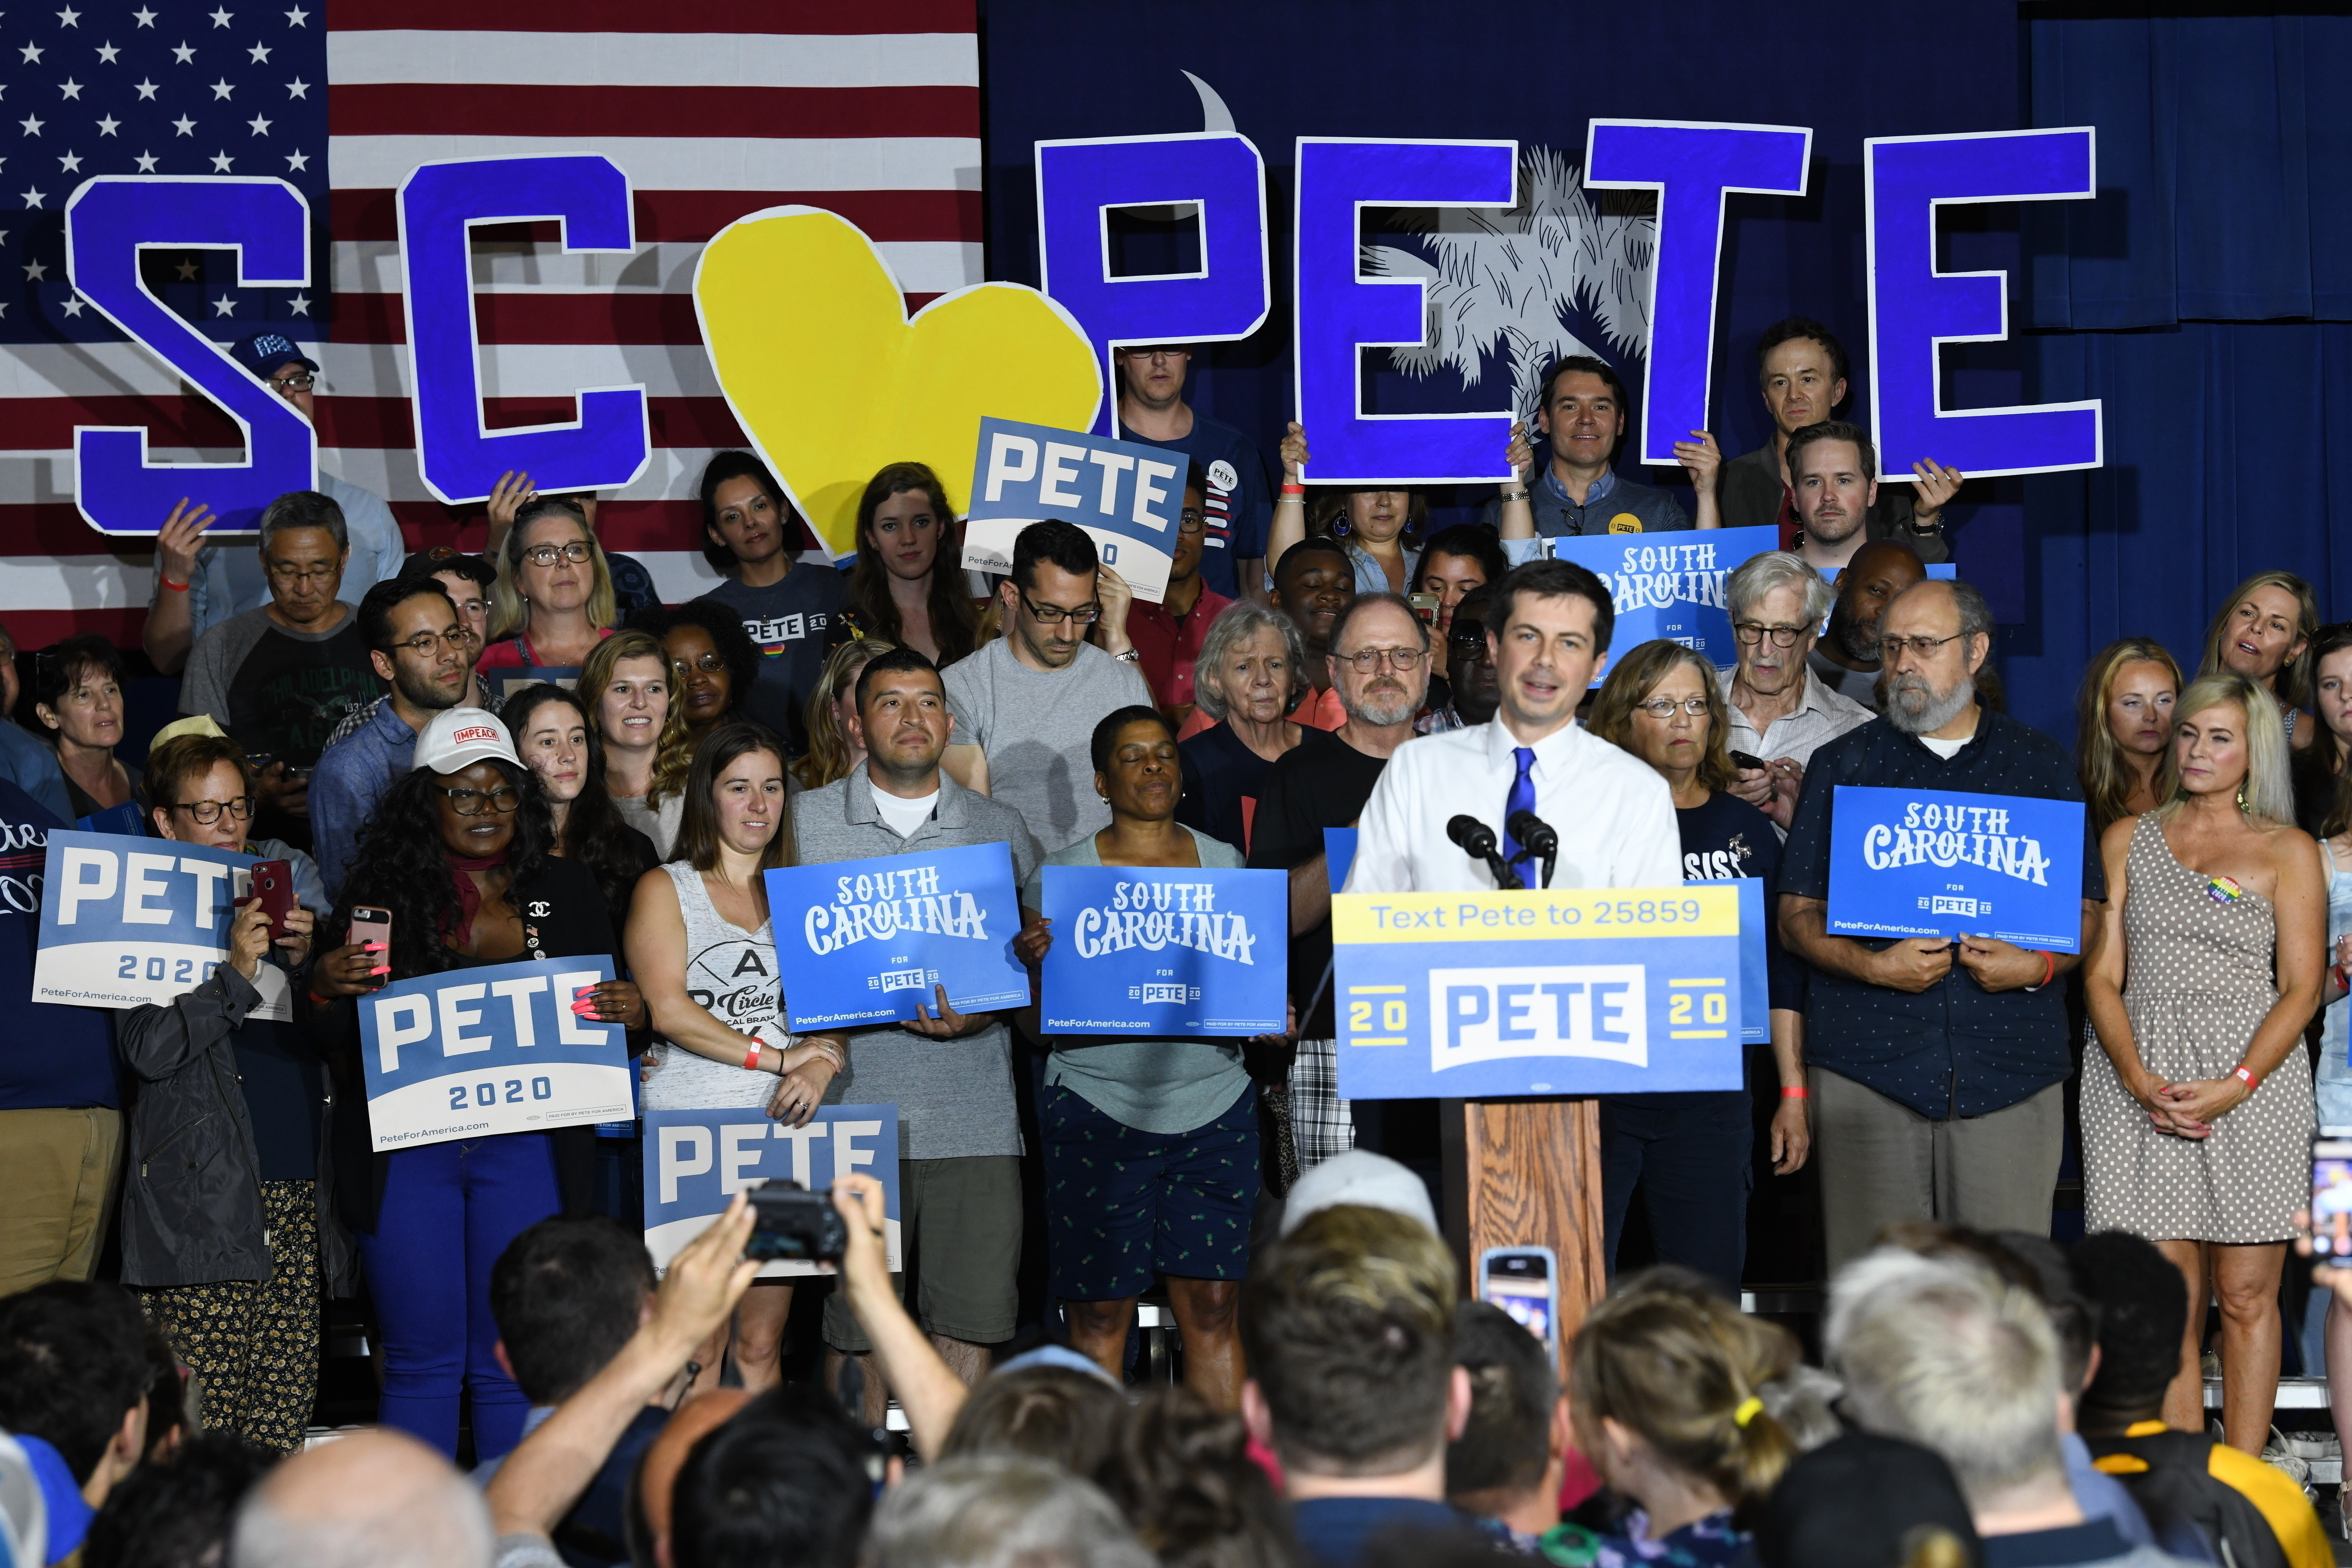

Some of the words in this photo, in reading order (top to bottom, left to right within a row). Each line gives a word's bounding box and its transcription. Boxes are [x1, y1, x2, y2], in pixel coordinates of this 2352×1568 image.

[1035, 117, 2103, 484] PETE
[985, 432, 1177, 533] PETE
[1214, 468, 1234, 484] PETE
[1622, 544, 1717, 574] SOUTH
[1596, 567, 1733, 615] AROLIN
[745, 618, 799, 639] PETE
[810, 618, 827, 628] 20
[457, 729, 497, 741] IMPEACH
[1904, 802, 2010, 835] SOUTH
[1864, 824, 2050, 887] CAROLINA
[58, 847, 252, 930] PET
[837, 866, 939, 905] SOUTH
[1112, 881, 1215, 912] SOUTH
[2212, 889, 2227, 901] 2020
[1370, 905, 1446, 929] Text
[1459, 904, 1536, 927] Pete
[1547, 904, 1582, 925] to
[1594, 899, 1700, 924] 25859
[1936, 899, 1974, 913] PETE
[805, 890, 989, 956] CAROLINA
[1075, 905, 1256, 966] CAROLINA
[1834, 921, 1939, 935] PeteForAmerica.com
[731, 949, 768, 977] A
[40, 988, 152, 1003] PeteForAmerica.com
[884, 972, 921, 989] PETE
[1146, 987, 1183, 1000] PETE
[717, 985, 774, 1017] Circle
[1349, 1001, 1407, 1031] 20
[1446, 982, 1630, 1049] PETE
[1669, 993, 1727, 1024] 20
[375, 970, 608, 1073] PETE
[795, 1008, 895, 1025] PeteForAmerica.com
[1048, 1019, 1150, 1028] PeteForAmerica.com
[450, 1076, 552, 1110] 2020
[380, 1121, 489, 1144] PeteForAmerica.com
[659, 1120, 883, 1204] PETE
